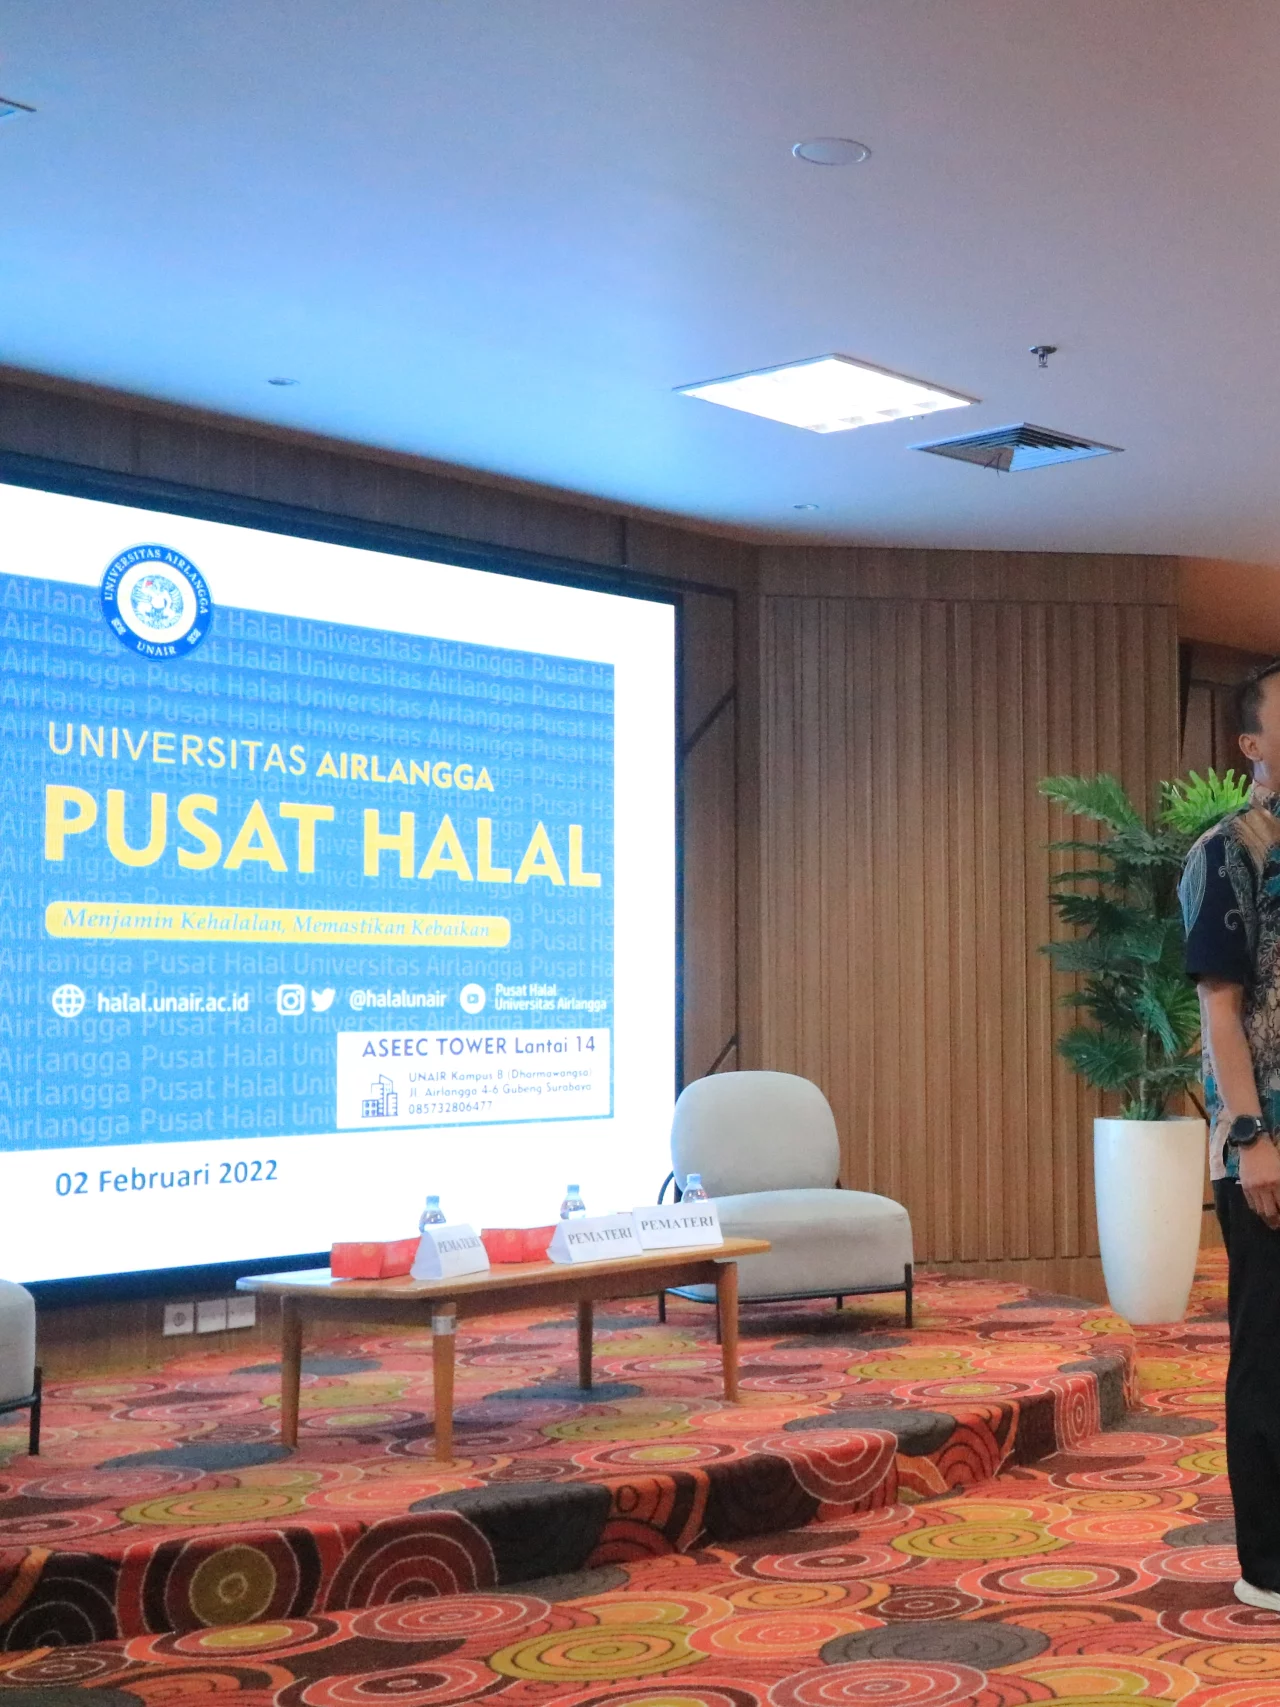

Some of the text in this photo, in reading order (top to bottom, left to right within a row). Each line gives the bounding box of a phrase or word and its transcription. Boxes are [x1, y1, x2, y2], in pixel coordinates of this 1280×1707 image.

[105, 548, 209, 614] UNIVERSITAS AIRLANGGA
[1, 576, 104, 623] Airlang
[228, 610, 289, 644] Halal
[296, 620, 423, 662] Universitas
[428, 640, 525, 680] Airlangga
[532, 657, 585, 685] Pusat
[1, 609, 123, 658] Airlangg
[228, 641, 289, 674] Halal
[296, 650, 422, 691] Universitas
[428, 668, 524, 707] Airlangga
[532, 684, 585, 712] Pusat
[132, 641, 177, 656] UNAIR
[0, 643, 136, 690] Airlangga
[147, 663, 219, 696] Pusat
[227, 671, 288, 704] Halal
[296, 680, 422, 719] Universitas
[428, 696, 524, 735] Airlangga
[531, 711, 585, 738] Pusat
[0, 677, 135, 722] Airlangga
[147, 695, 219, 727] Pusat
[227, 702, 288, 734] Halal
[295, 710, 422, 748] Universitas
[427, 725, 524, 762] Airlangga
[531, 738, 585, 765] Pusat
[49, 721, 306, 775] UNIVERSITAS
[316, 751, 495, 792] AIRLANGGA
[45, 783, 334, 873] PUSAT
[363, 808, 602, 887] HALAL
[63, 906, 174, 933] Menjamin
[180, 910, 286, 935] Kehalalan,
[293, 914, 405, 936] Memastikan
[411, 918, 490, 938] Kebaikan
[0, 945, 132, 980] Airlangga
[143, 950, 216, 975] Pusat
[224, 949, 286, 975] Halal
[293, 950, 419, 976] Universitas
[426, 953, 522, 982] Airlangga
[530, 956, 584, 978] Pusat
[97, 991, 249, 1013] halal.unair.ac.id
[349, 988, 448, 1011] @halalunair
[495, 983, 528, 996] Pusat
[529, 983, 557, 996] Halal
[495, 998, 607, 1012] Universitas Airlangga
[0, 1045, 131, 1077] Airlangga
[142, 1044, 215, 1070] Pusat
[223, 1041, 285, 1068] Halal
[362, 1035, 596, 1057] ASEEC TOWER Lantai 14
[0, 1078, 131, 1110] Airlangga
[141, 1075, 214, 1102] Pusat
[222, 1071, 285, 1099] Halal
[409, 1071, 447, 1082] UNAIR
[451, 1071, 493, 1082] Kampus
[497, 1069, 504, 1080] B
[424, 1086, 477, 1098] Airlangga
[482, 1085, 499, 1095] 4-6
[503, 1083, 542, 1096] Gubeng
[546, 1082, 592, 1094] Surabaya
[0, 1111, 130, 1143] Airlangga
[141, 1106, 214, 1134] Pusat
[222, 1101, 285, 1130] Halal
[408, 1100, 493, 1115] 085732806477
[55, 1159, 278, 1196] 02 Februari 2022
[567, 1226, 633, 1245] PEMATERI
[640, 1214, 714, 1231] PEMATERI
[437, 1236, 481, 1254] PEMATERI
